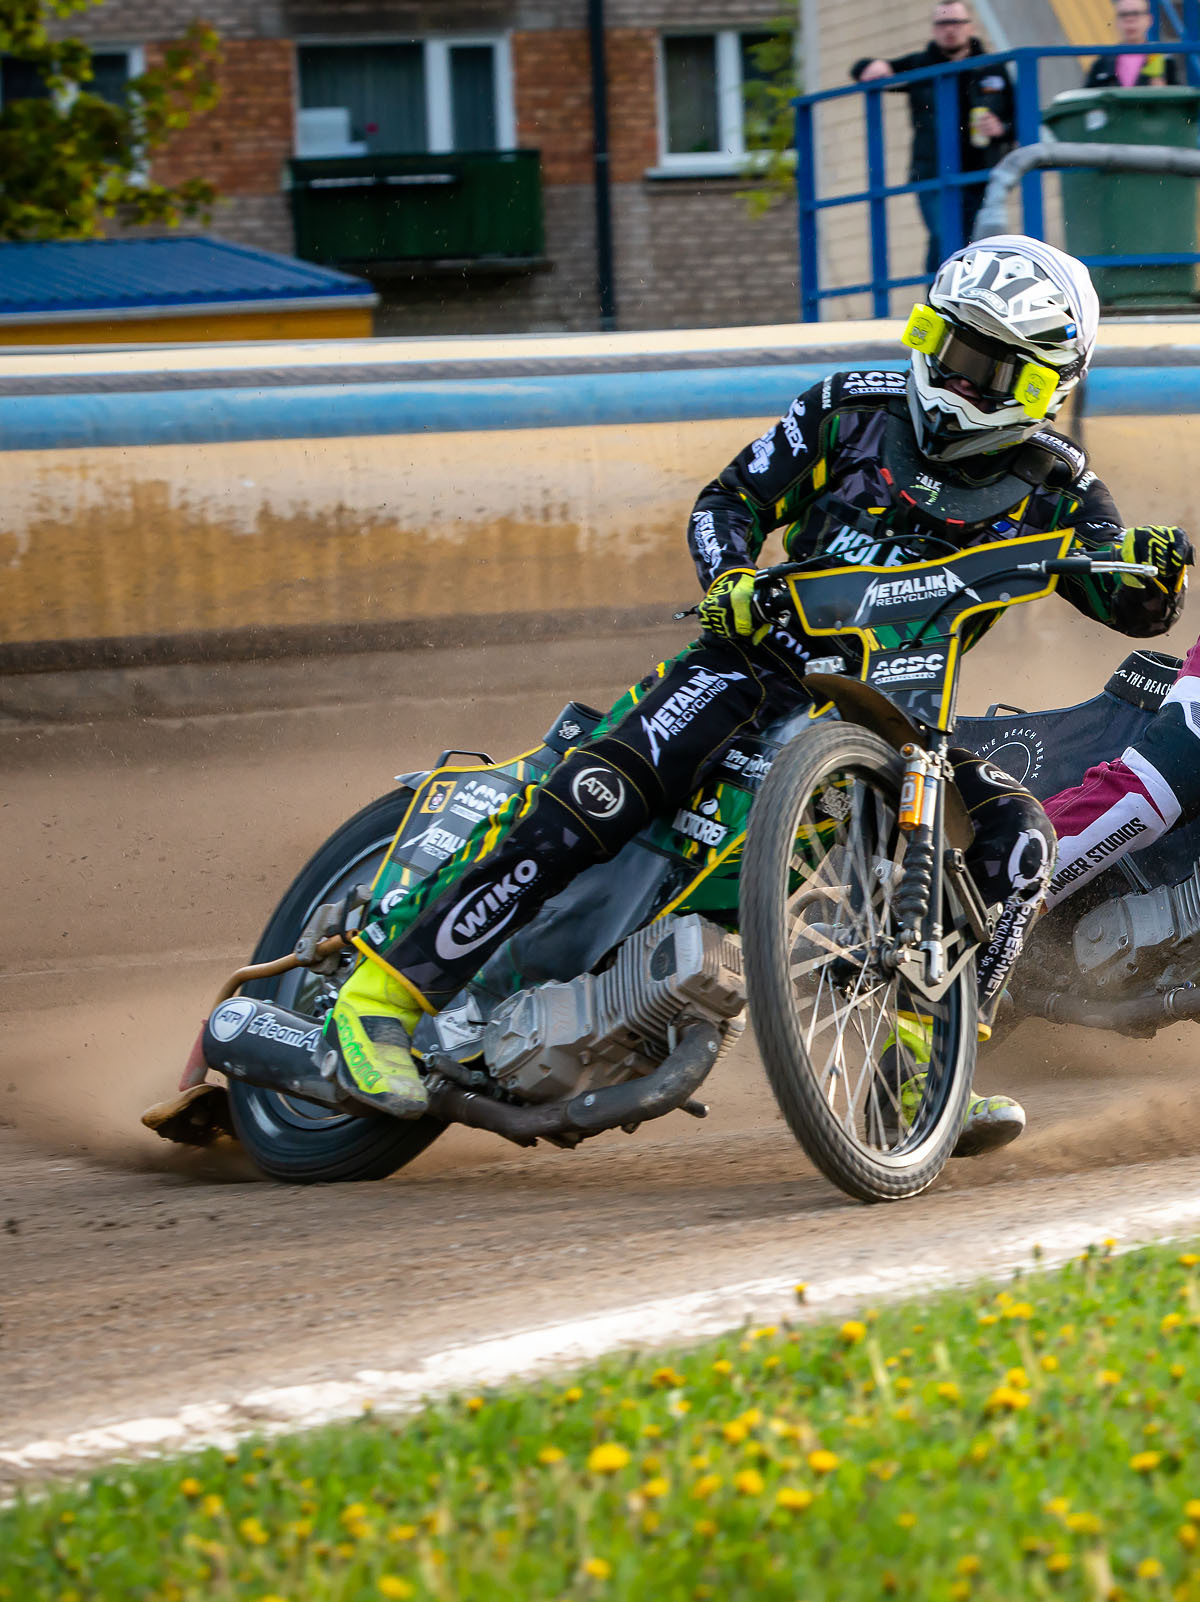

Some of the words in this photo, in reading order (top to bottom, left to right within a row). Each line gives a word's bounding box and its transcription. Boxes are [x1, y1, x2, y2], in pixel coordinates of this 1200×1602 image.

[843, 371, 907, 388] ACD
[853, 566, 982, 623] METALIKA
[875, 589, 948, 607] RECYCLING
[870, 653, 945, 679] ACDC
[1126, 671, 1143, 688] THE
[1143, 678, 1173, 697] BEACH
[668, 679, 729, 736] RECYCLING
[975, 738, 996, 757] THE
[1003, 728, 1037, 740] BEACH
[1030, 741, 1044, 779] BREAK
[579, 777, 618, 810] ATPI
[1085, 817, 1148, 864] STUDIOS
[1047, 857, 1094, 896] AMBER
[454, 859, 539, 939] WIKO
[987, 898, 1016, 955] ECYKLING
[217, 1010, 242, 1025] ATPI
[247, 1012, 322, 1052] #teamA
